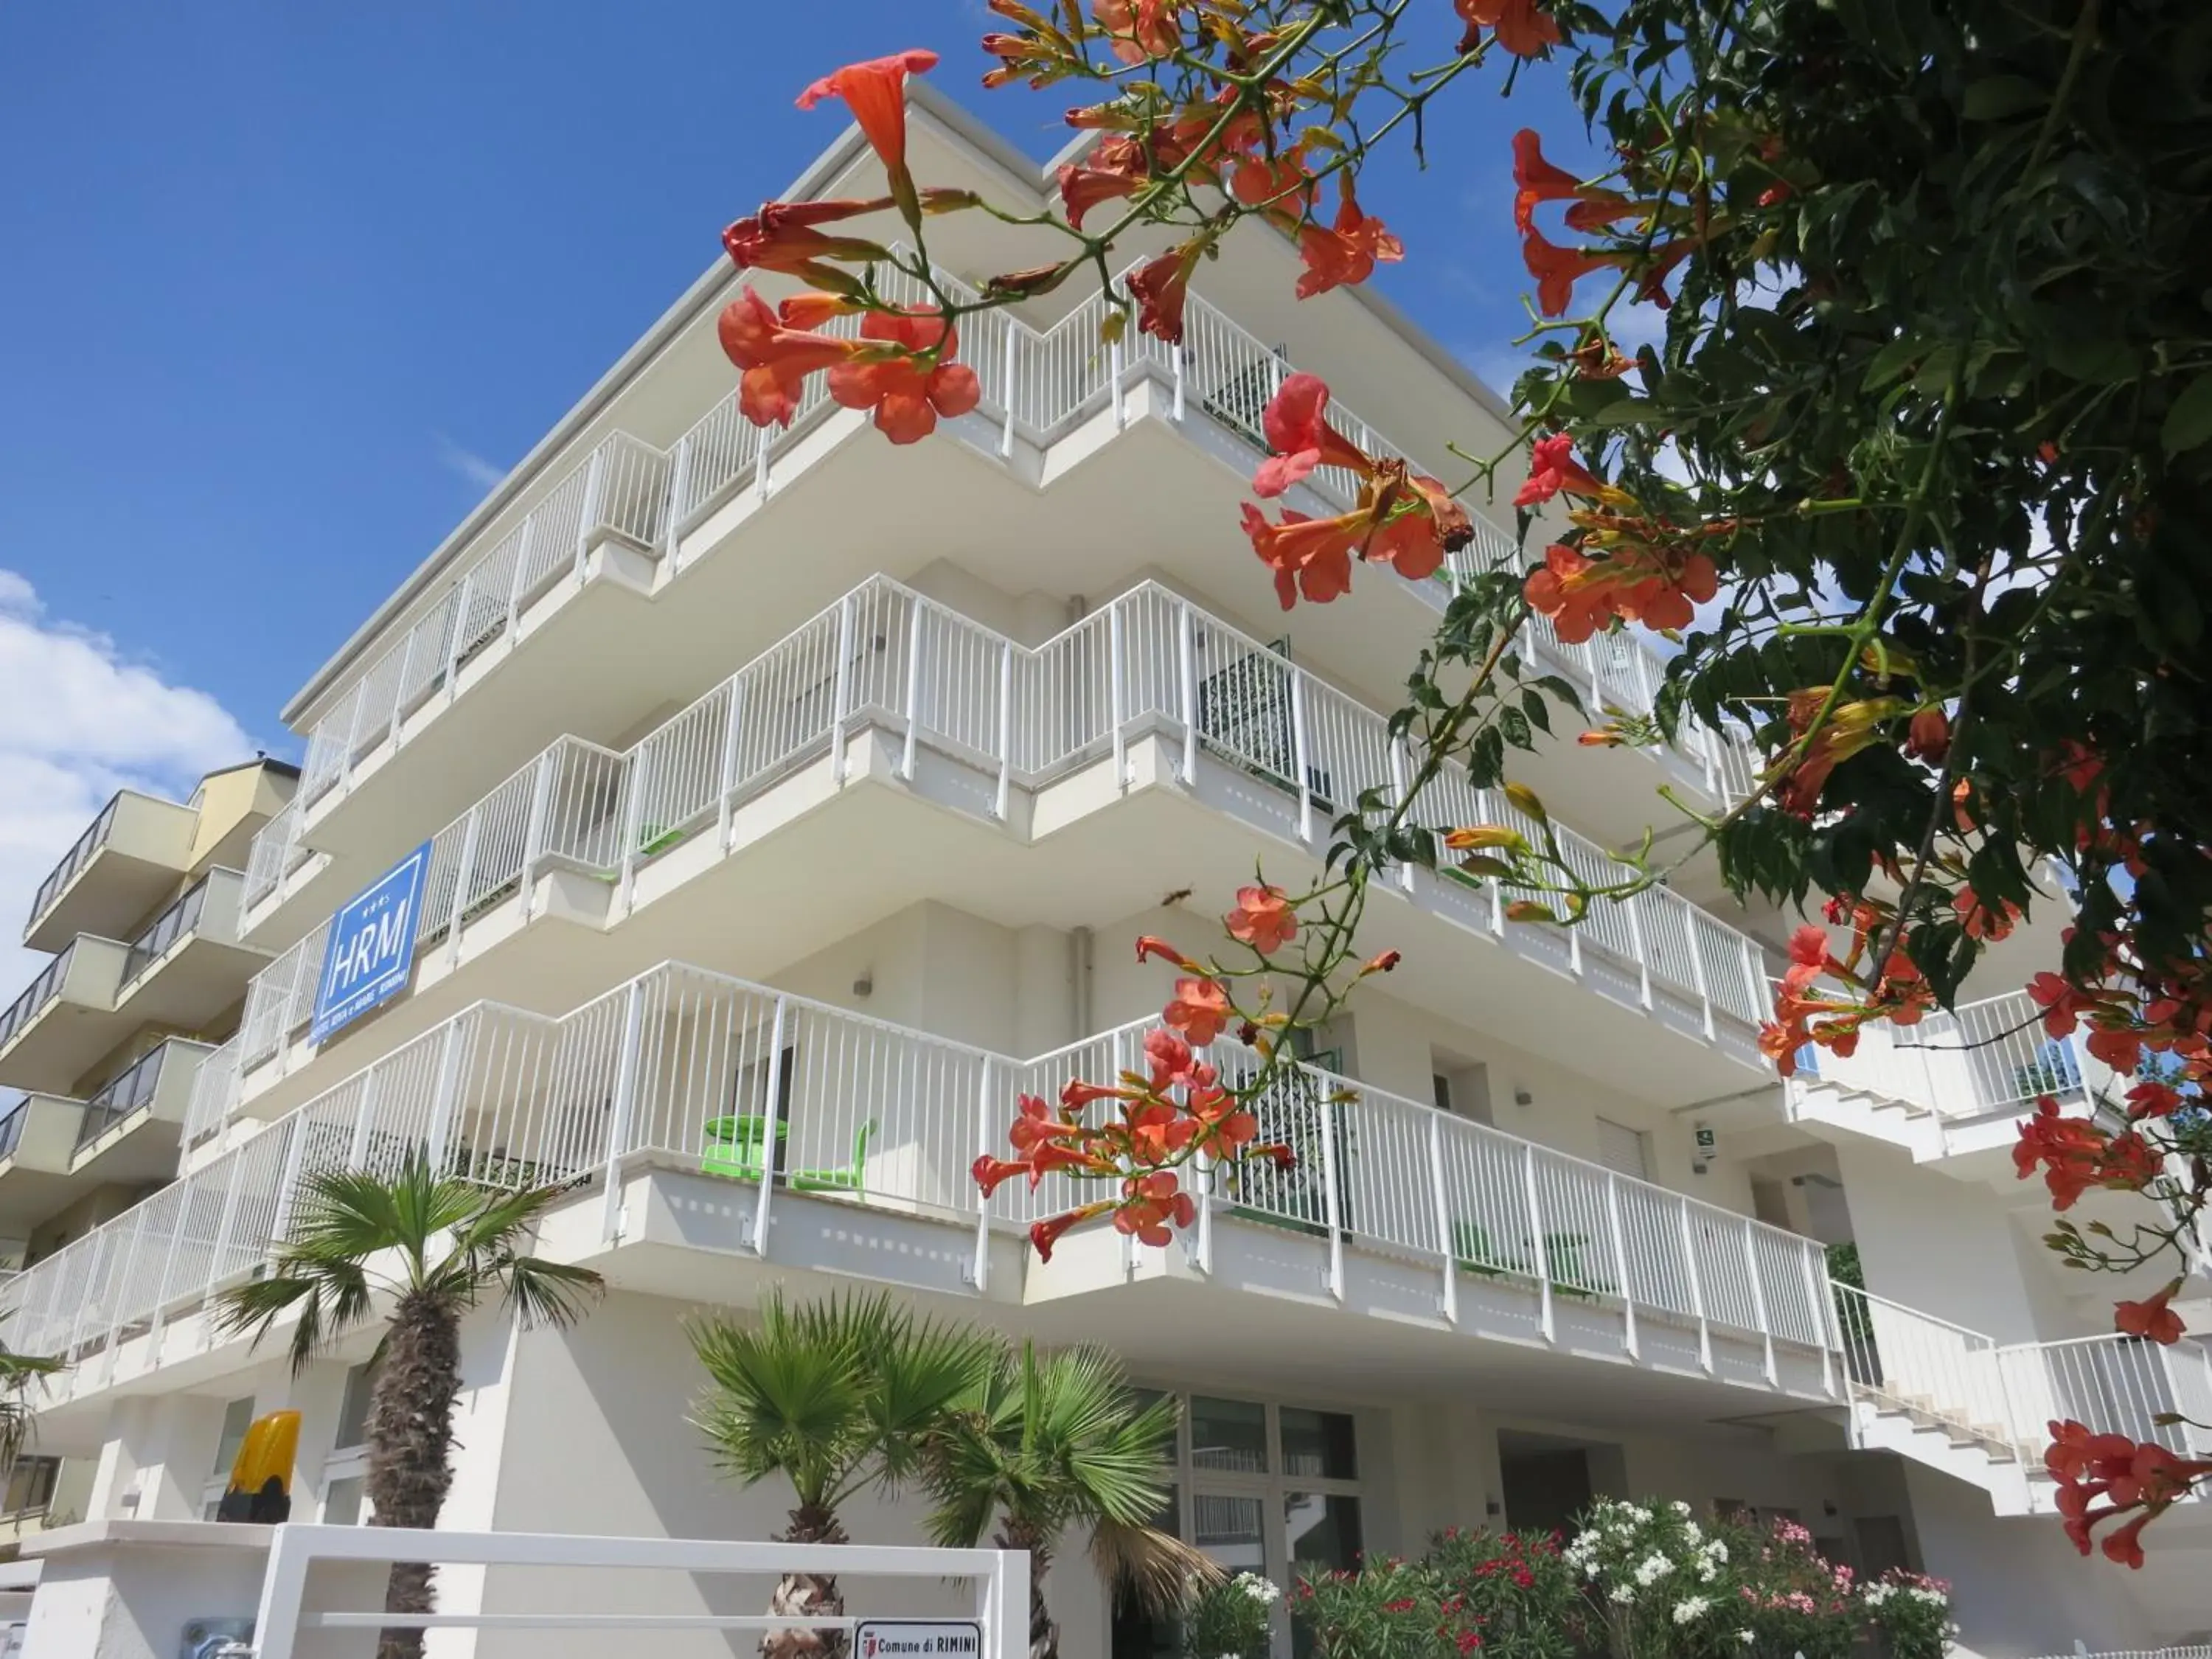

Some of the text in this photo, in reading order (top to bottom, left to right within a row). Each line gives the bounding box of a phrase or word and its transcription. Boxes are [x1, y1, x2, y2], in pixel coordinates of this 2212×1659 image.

[328, 897, 407, 998] HRM
[878, 1635, 975, 1653] Comune di RIMINI
